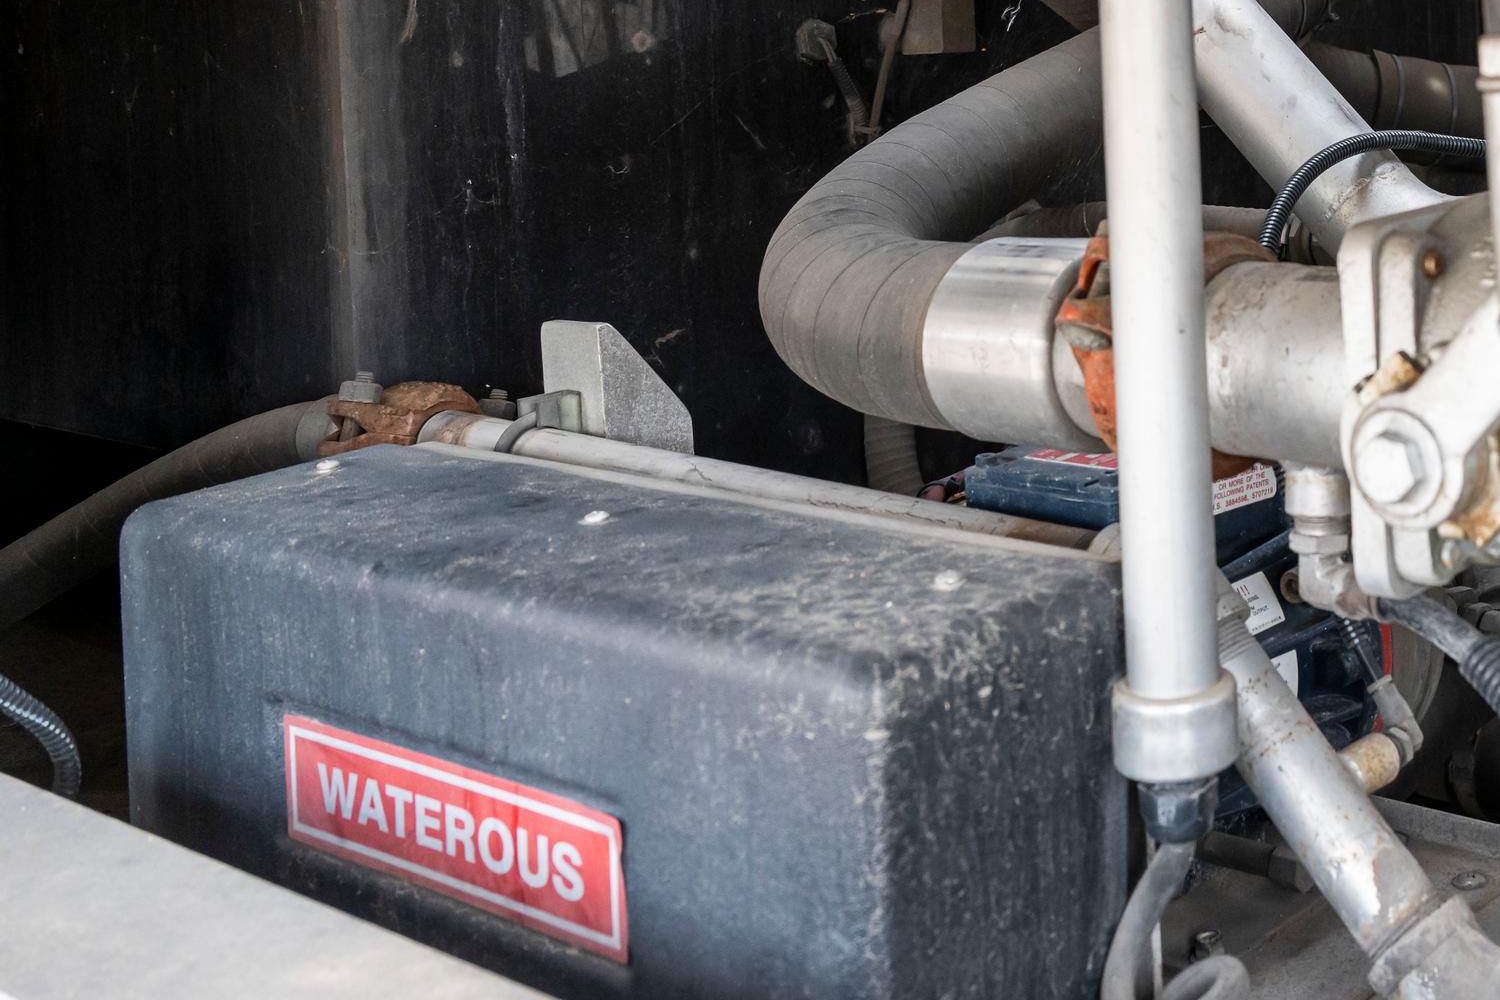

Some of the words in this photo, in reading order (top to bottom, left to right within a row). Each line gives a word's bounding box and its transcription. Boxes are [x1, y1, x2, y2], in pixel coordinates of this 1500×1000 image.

[1218, 482, 1227, 490] OR
[1228, 478, 1244, 488] MORE
[1246, 475, 1253, 483] OF
[1255, 472, 1265, 480] THE
[1214, 486, 1244, 499] FOLLOWING
[317, 761, 586, 903] WATEROUS
